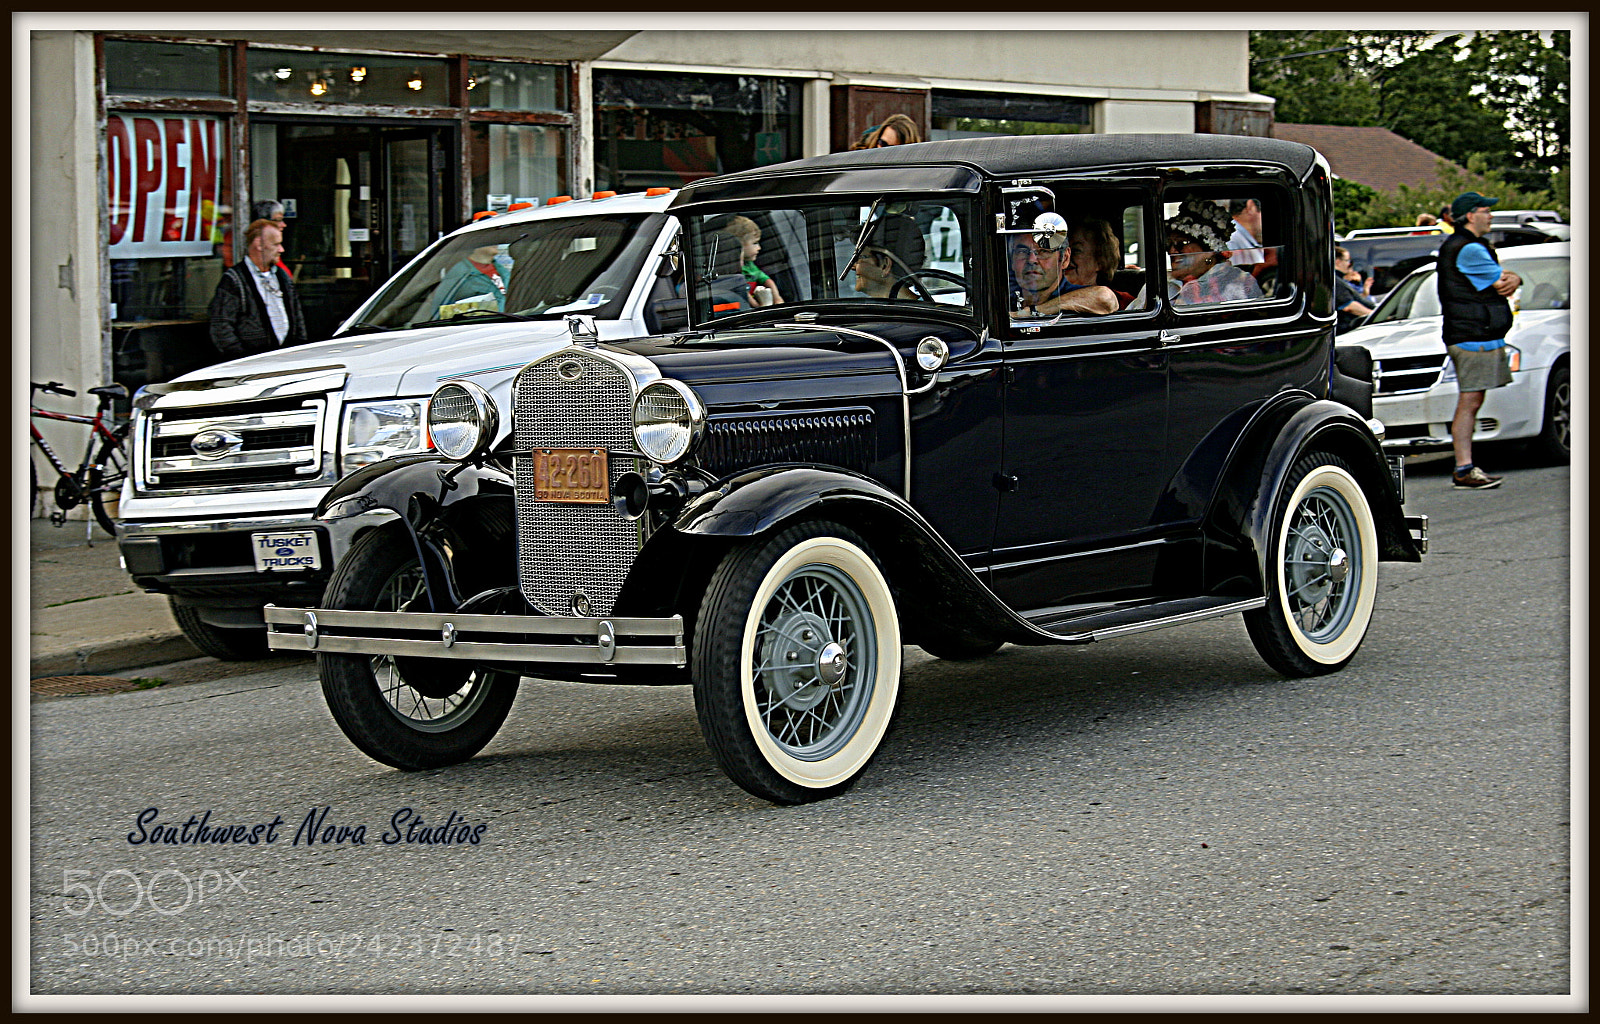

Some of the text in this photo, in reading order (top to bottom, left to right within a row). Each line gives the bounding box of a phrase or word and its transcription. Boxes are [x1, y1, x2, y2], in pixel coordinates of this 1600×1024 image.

[108, 114, 216, 246] OPEN
[539, 454, 603, 488] 42-260
[551, 489, 571, 499] NOVA
[574, 490, 605, 500] SCOTIA
[258, 537, 312, 548] TUSKET
[261, 557, 314, 567] TRUCKS
